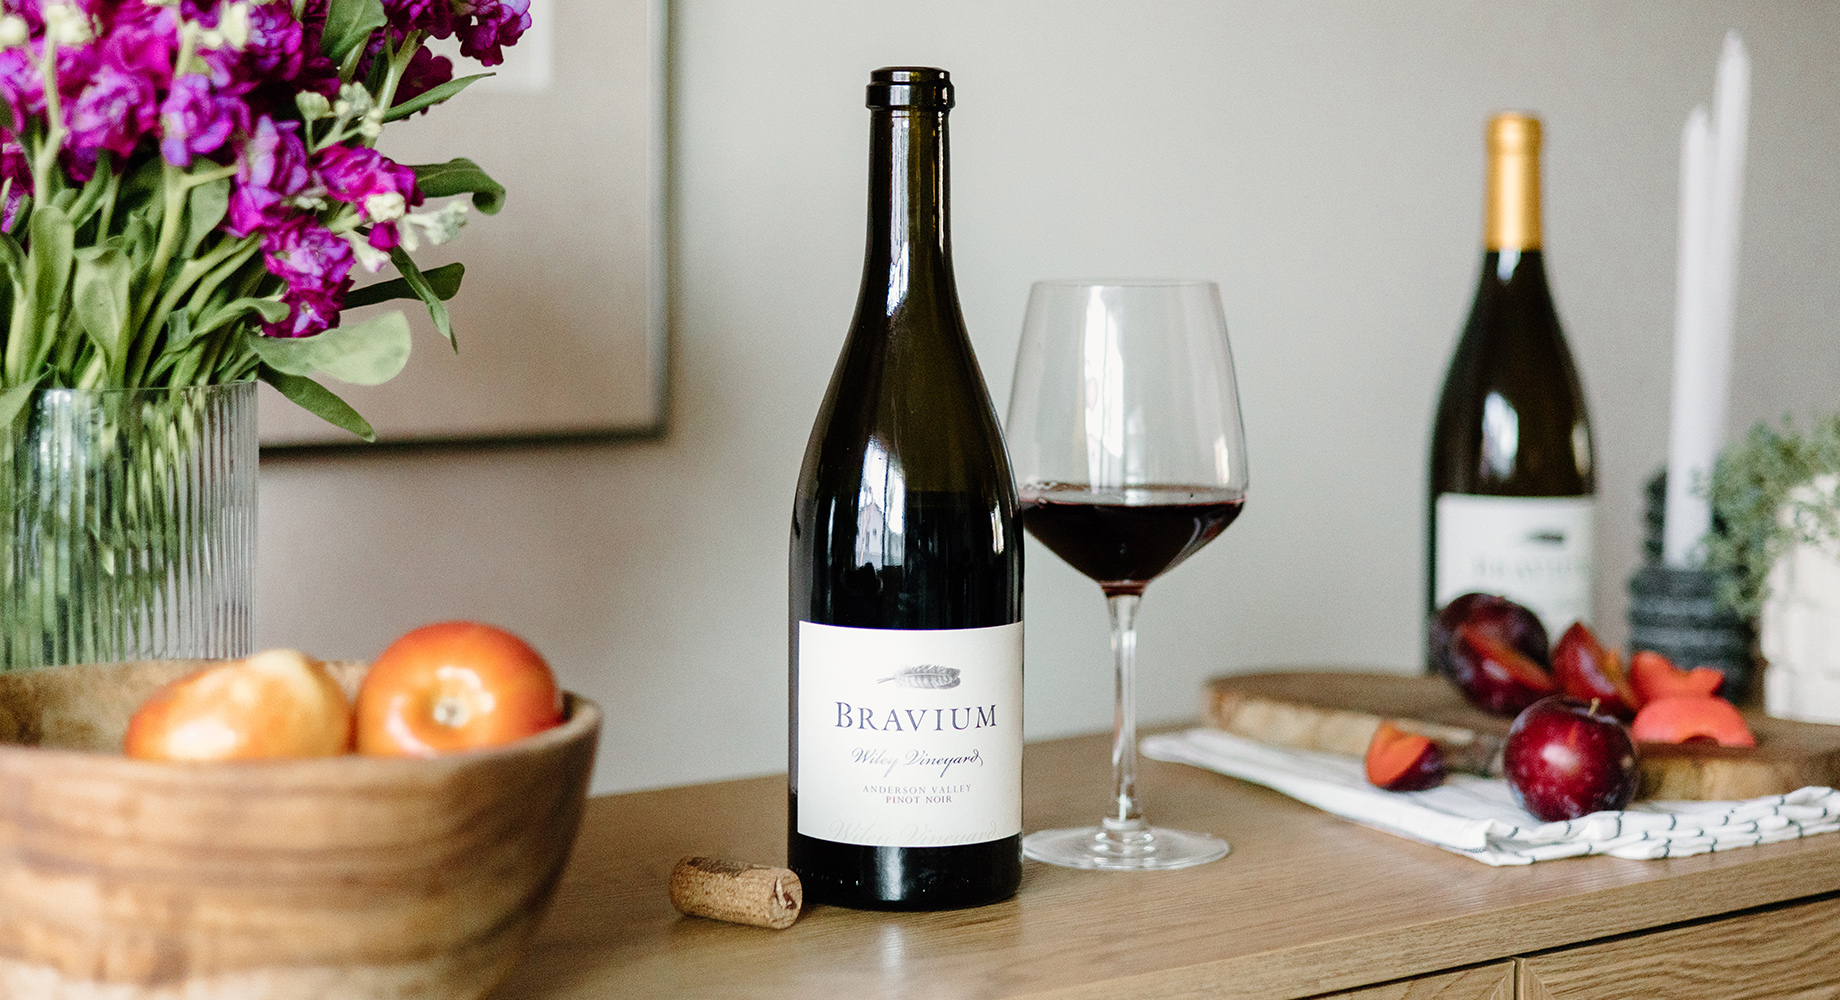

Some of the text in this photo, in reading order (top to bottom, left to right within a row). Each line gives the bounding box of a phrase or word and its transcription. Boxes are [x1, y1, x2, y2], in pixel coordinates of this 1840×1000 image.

[834, 700, 998, 732] BRAVIUM
[851, 748, 984, 778] Wiley Vineyard
[863, 784, 972, 795] ANDERSON VALLEY
[886, 795, 953, 804] PINOT NOIR
